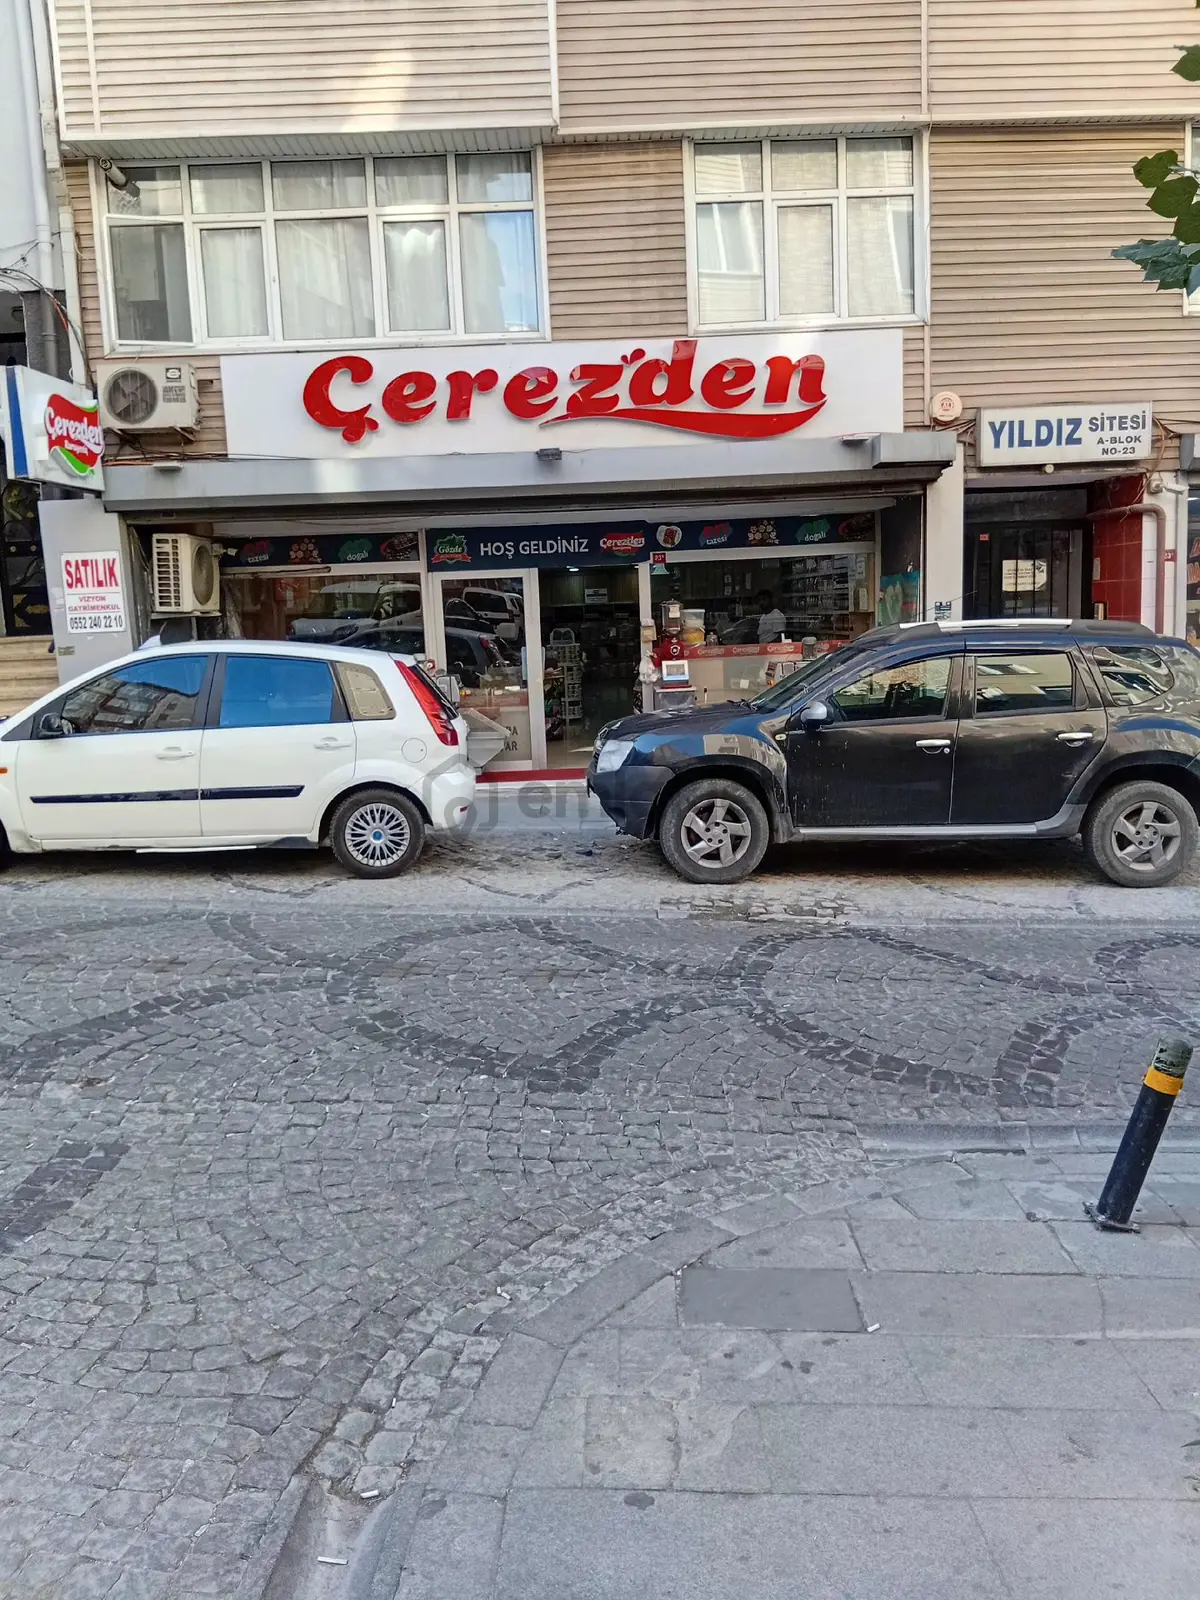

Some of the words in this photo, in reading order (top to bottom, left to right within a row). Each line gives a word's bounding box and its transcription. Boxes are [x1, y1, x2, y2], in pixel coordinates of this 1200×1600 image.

[988, 418, 1083, 449] YILDIZ
[1088, 411, 1147, 433] SİTESİ
[1097, 435, 1142, 445] A-BLOK
[1101, 447, 1137, 456] NO-23
[438, 545, 463, 554] Gözde
[480, 542, 515, 559] HOŞ
[519, 535, 589, 555] GELDİNİZ
[65, 558, 119, 589] SATILIK
[69, 617, 88, 630] 0552
[89, 615, 103, 630] 240
[103, 615, 113, 628] 22
[114, 614, 124, 628] 10
